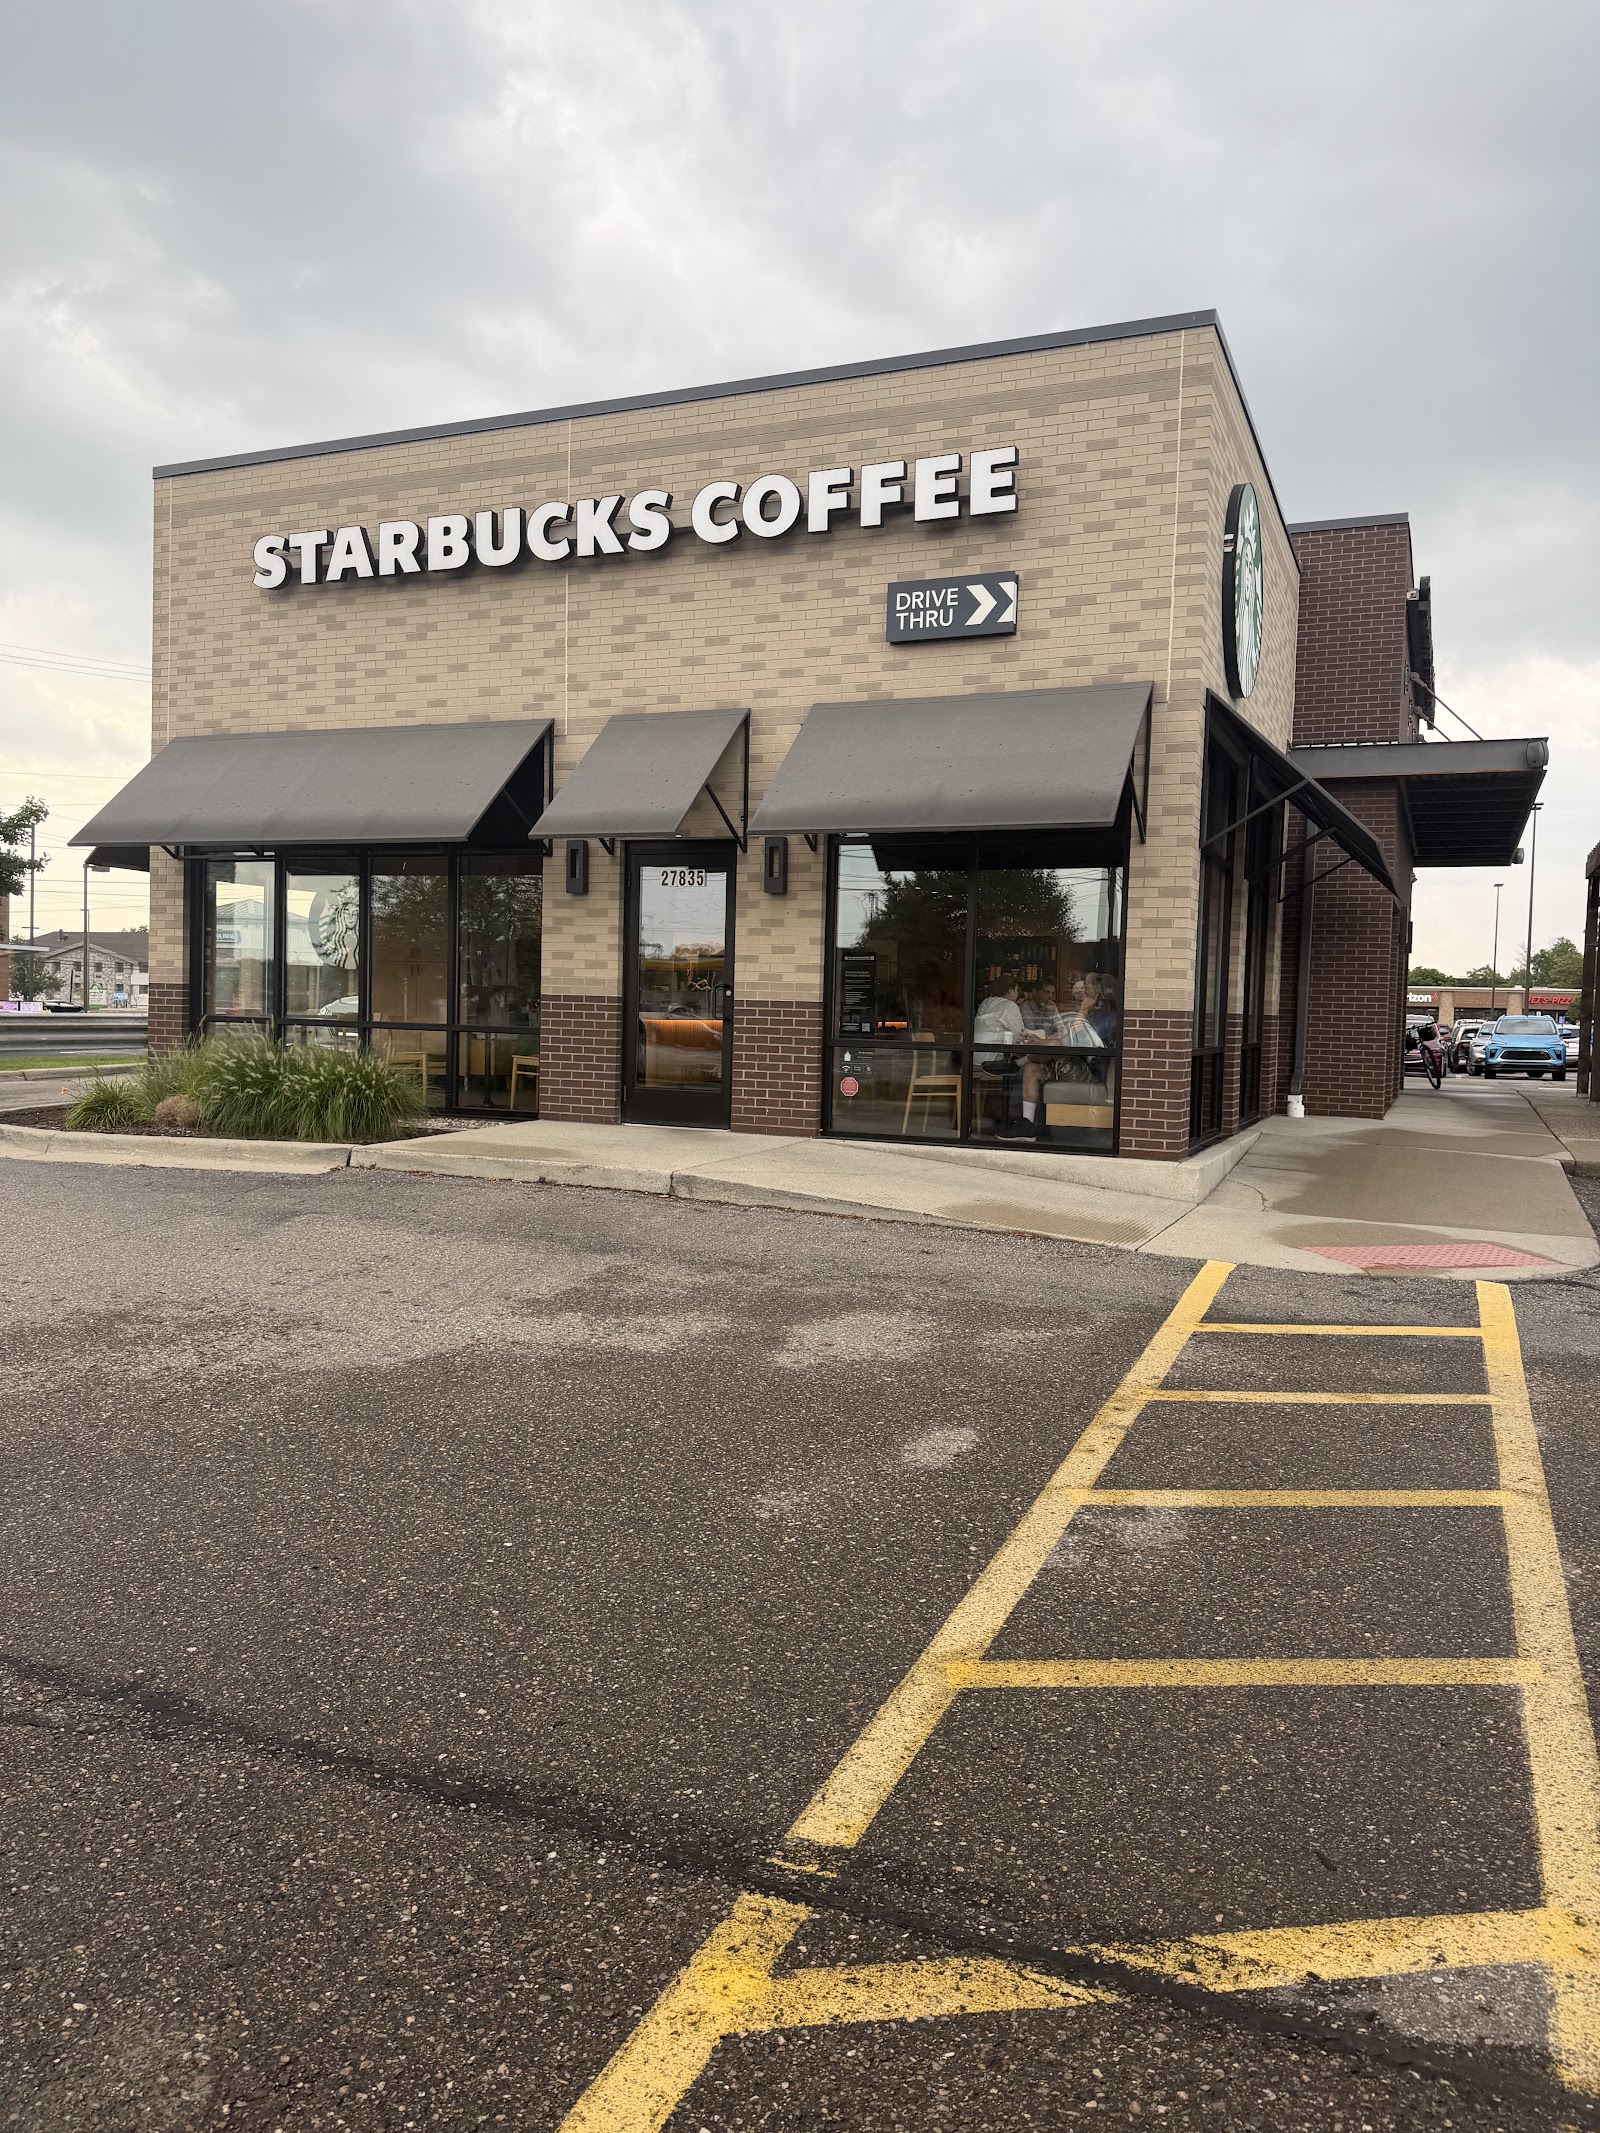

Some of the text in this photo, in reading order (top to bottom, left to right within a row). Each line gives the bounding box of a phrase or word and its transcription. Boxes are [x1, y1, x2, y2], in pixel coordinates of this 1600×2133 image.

[253, 446, 1018, 589] STARBUCKS COFFEE
[895, 587, 959, 611] DRIVE
[895, 608, 954, 630] THRU
[661, 870, 704, 886] 27835
